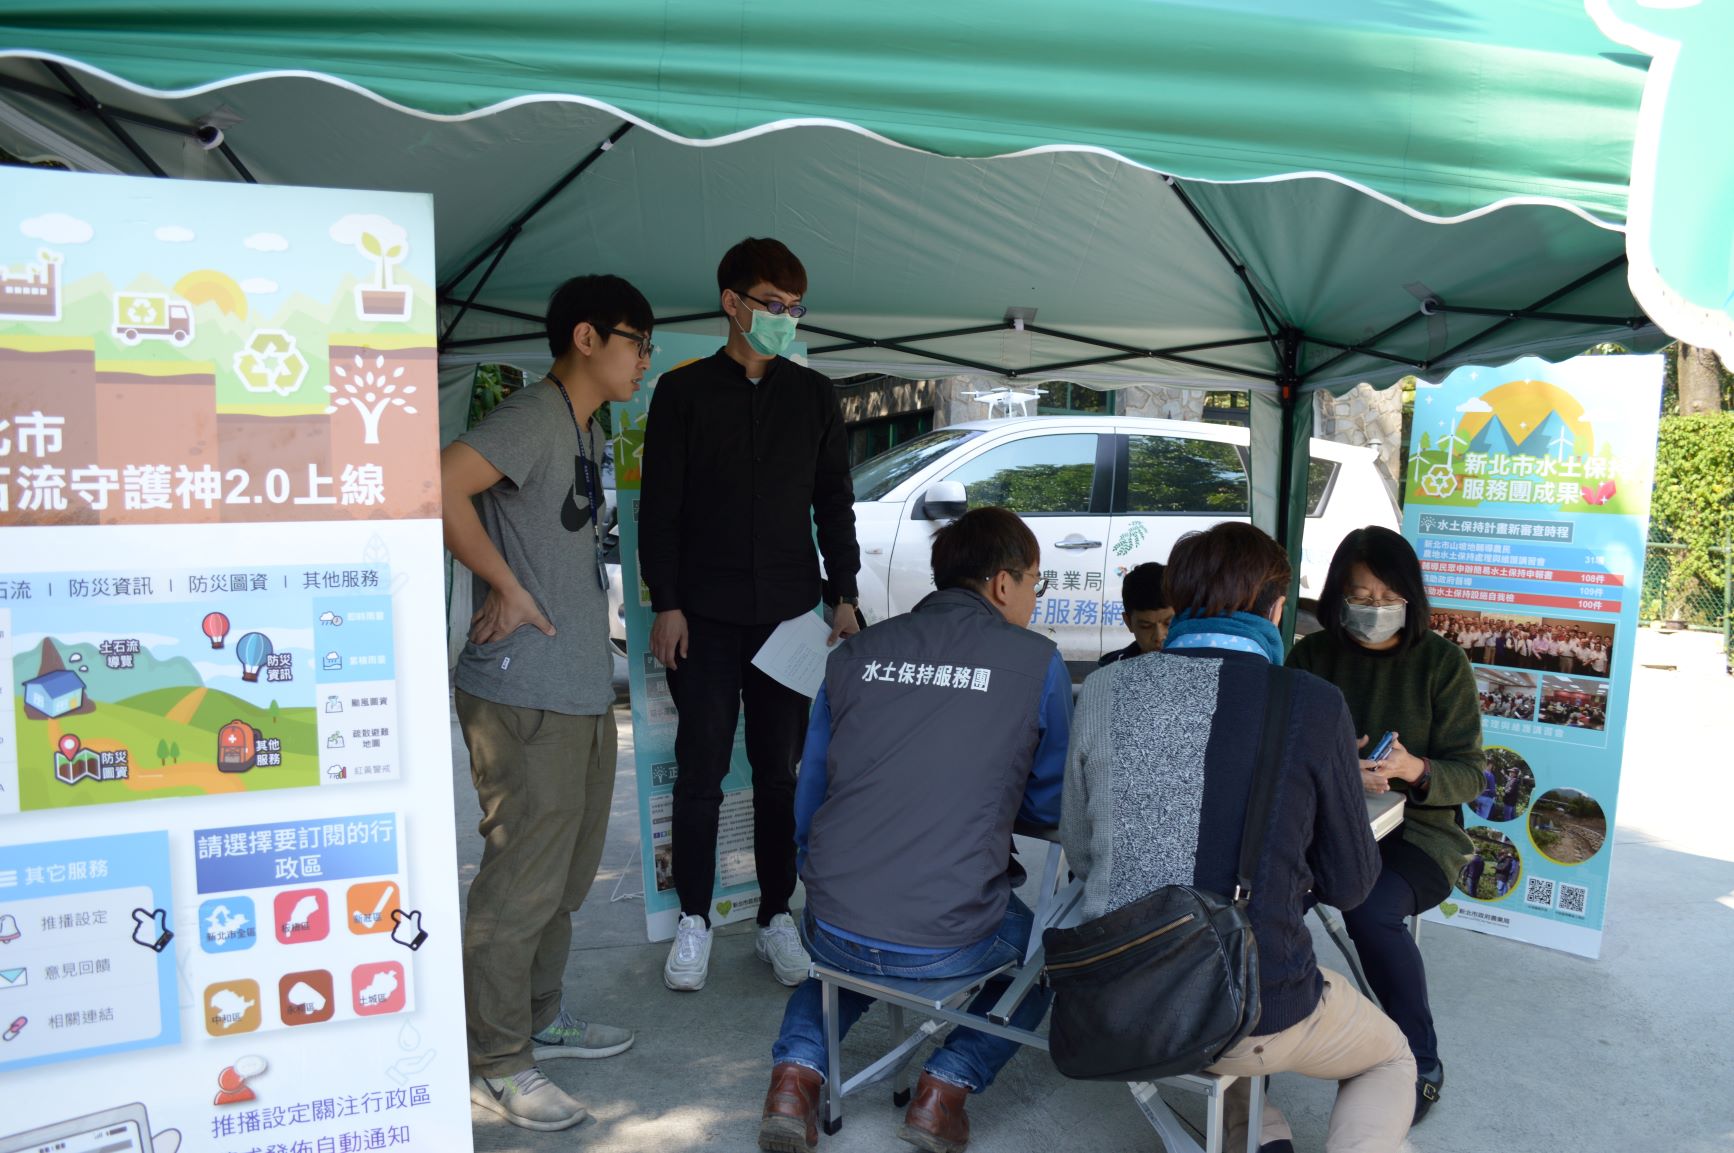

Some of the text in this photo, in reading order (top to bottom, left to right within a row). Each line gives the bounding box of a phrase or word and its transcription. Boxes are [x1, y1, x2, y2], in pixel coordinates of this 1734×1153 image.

[0, 411, 65, 458] 市
[0, 463, 386, 512] 流守護神2.0上線
[1462, 480, 1582, 506] 服務團成果
[68, 577, 154, 598] 防災資訊
[188, 573, 269, 593] 防災圖資
[302, 570, 380, 591] 其他服務
[100, 639, 140, 655] 土石流
[266, 654, 291, 668] 防災
[267, 667, 293, 681] 資訊
[862, 660, 991, 692] 水土保持服務團
[256, 738, 280, 752] 其他
[101, 751, 128, 766] 防災
[256, 752, 281, 767] 服務
[197, 820, 393, 860] 請選擇要訂閱的行
[24, 859, 109, 886] 其它服務
[274, 854, 323, 881] 政區
[40, 909, 108, 931] 推播設定
[44, 959, 111, 982] 意見回饋
[48, 1007, 115, 1031] 相關連結
[211, 1084, 431, 1139] 推播設定關注行政區
[222, 1125, 410, 1153] 發佈自動通知
